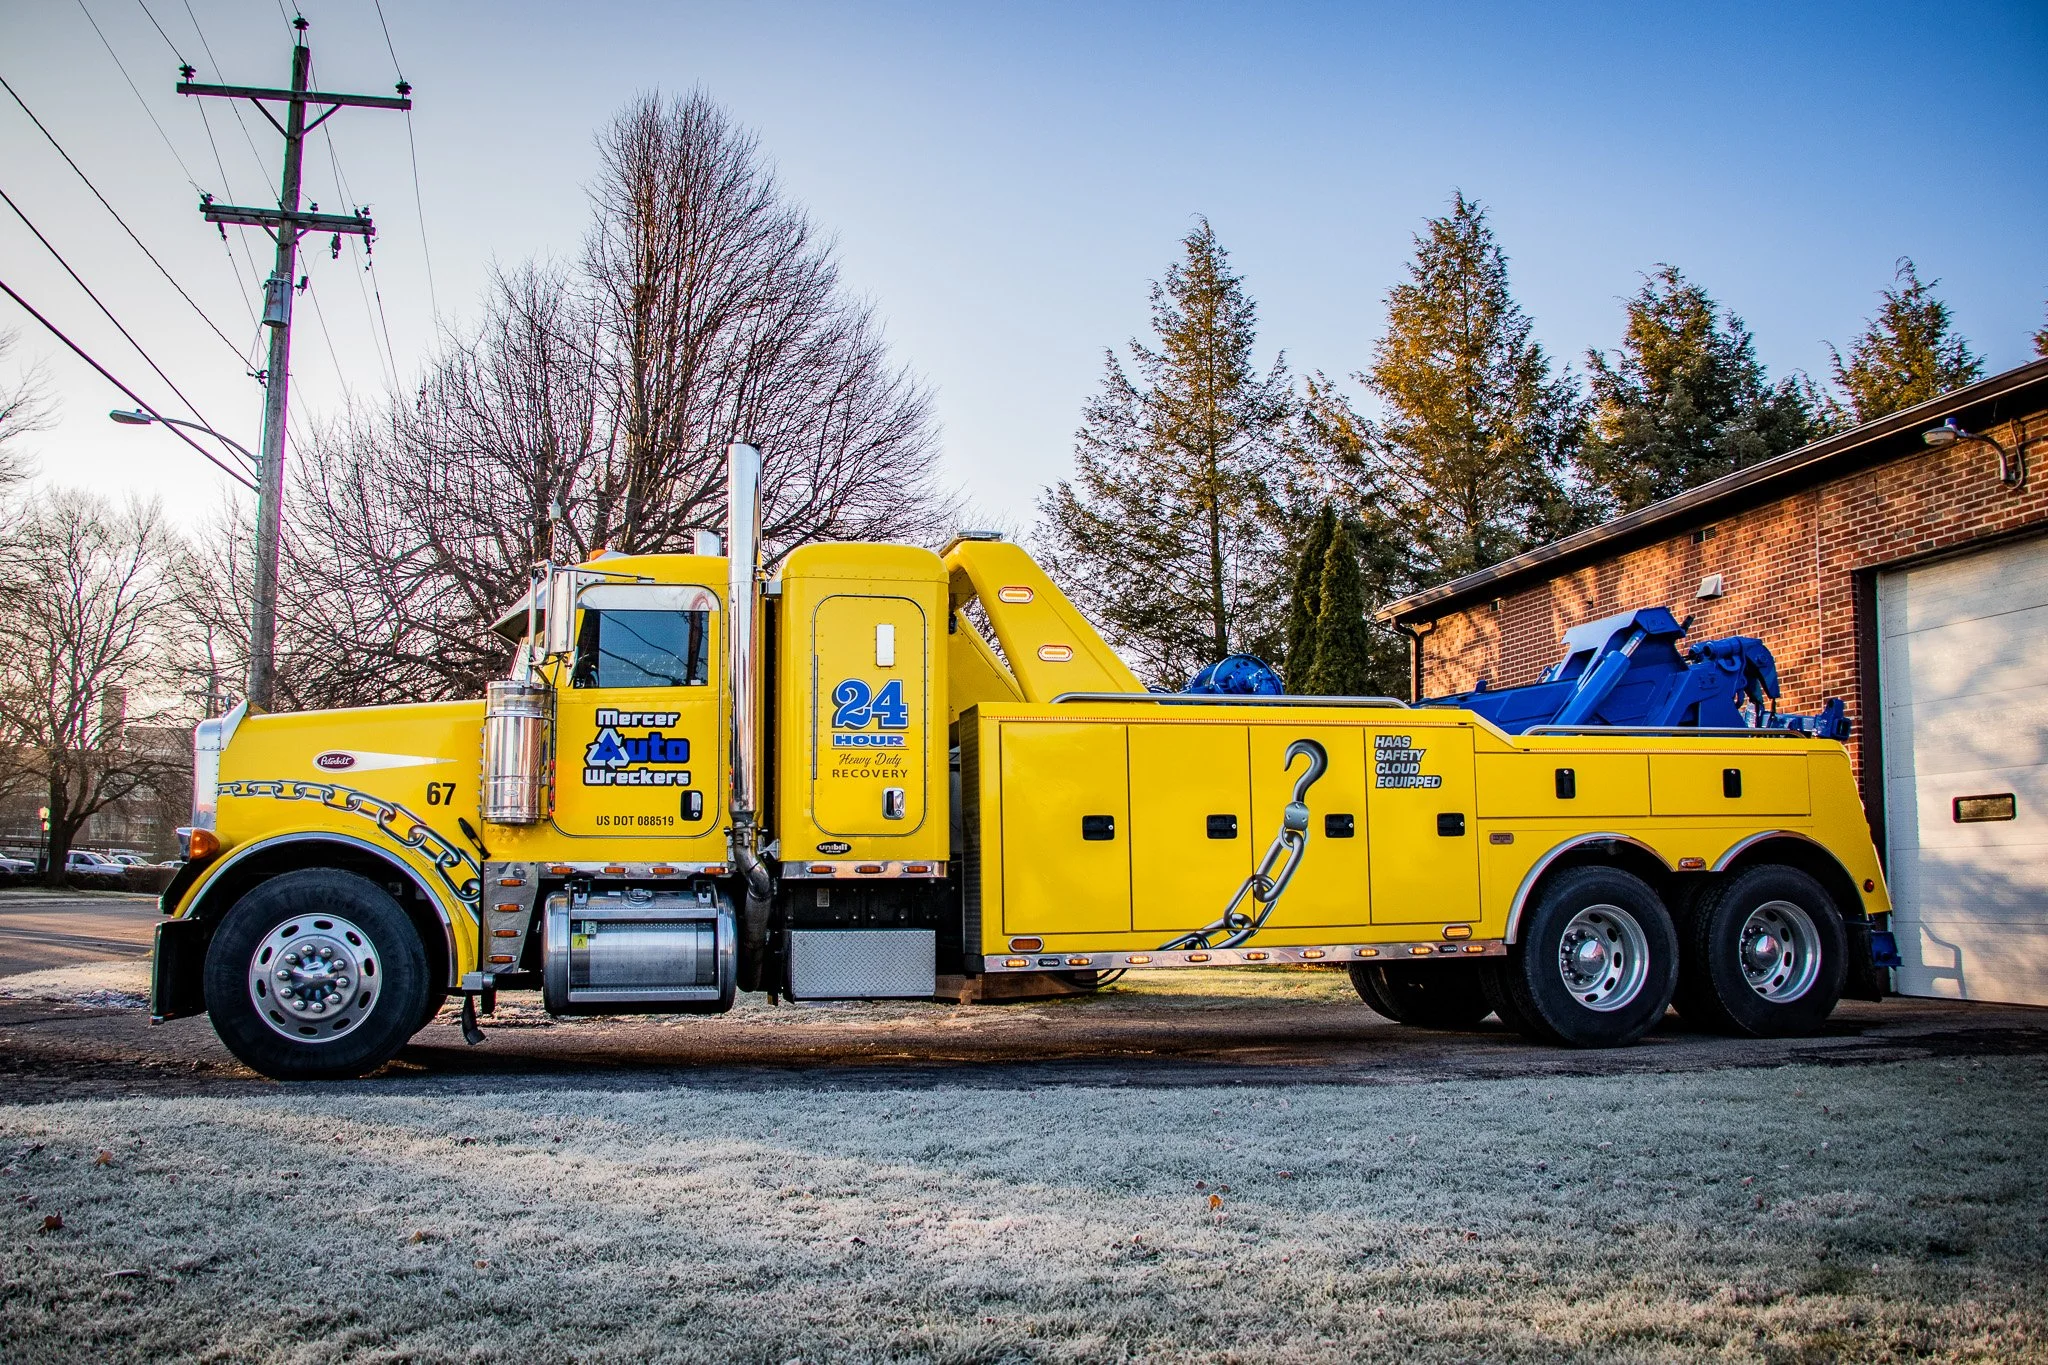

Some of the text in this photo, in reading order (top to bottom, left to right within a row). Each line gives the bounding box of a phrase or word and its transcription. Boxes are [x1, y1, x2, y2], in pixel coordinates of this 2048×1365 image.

[832, 678, 909, 730] 24
[597, 708, 681, 727] Mercer
[833, 733, 906, 747] HOUR
[1374, 735, 1412, 748] HAAS
[585, 729, 690, 765] Auto
[320, 755, 352, 766] Peterbilt
[839, 752, 902, 768] Heavy Duty
[1375, 749, 1426, 761] SAFETY
[832, 769, 908, 778] RECOVERY
[1375, 762, 1420, 775] CLOUD
[583, 767, 691, 786] Wreckers
[1376, 775, 1442, 788] EQUIPPED
[426, 781, 457, 806] 67
[596, 815, 674, 826] US DOT 088519
